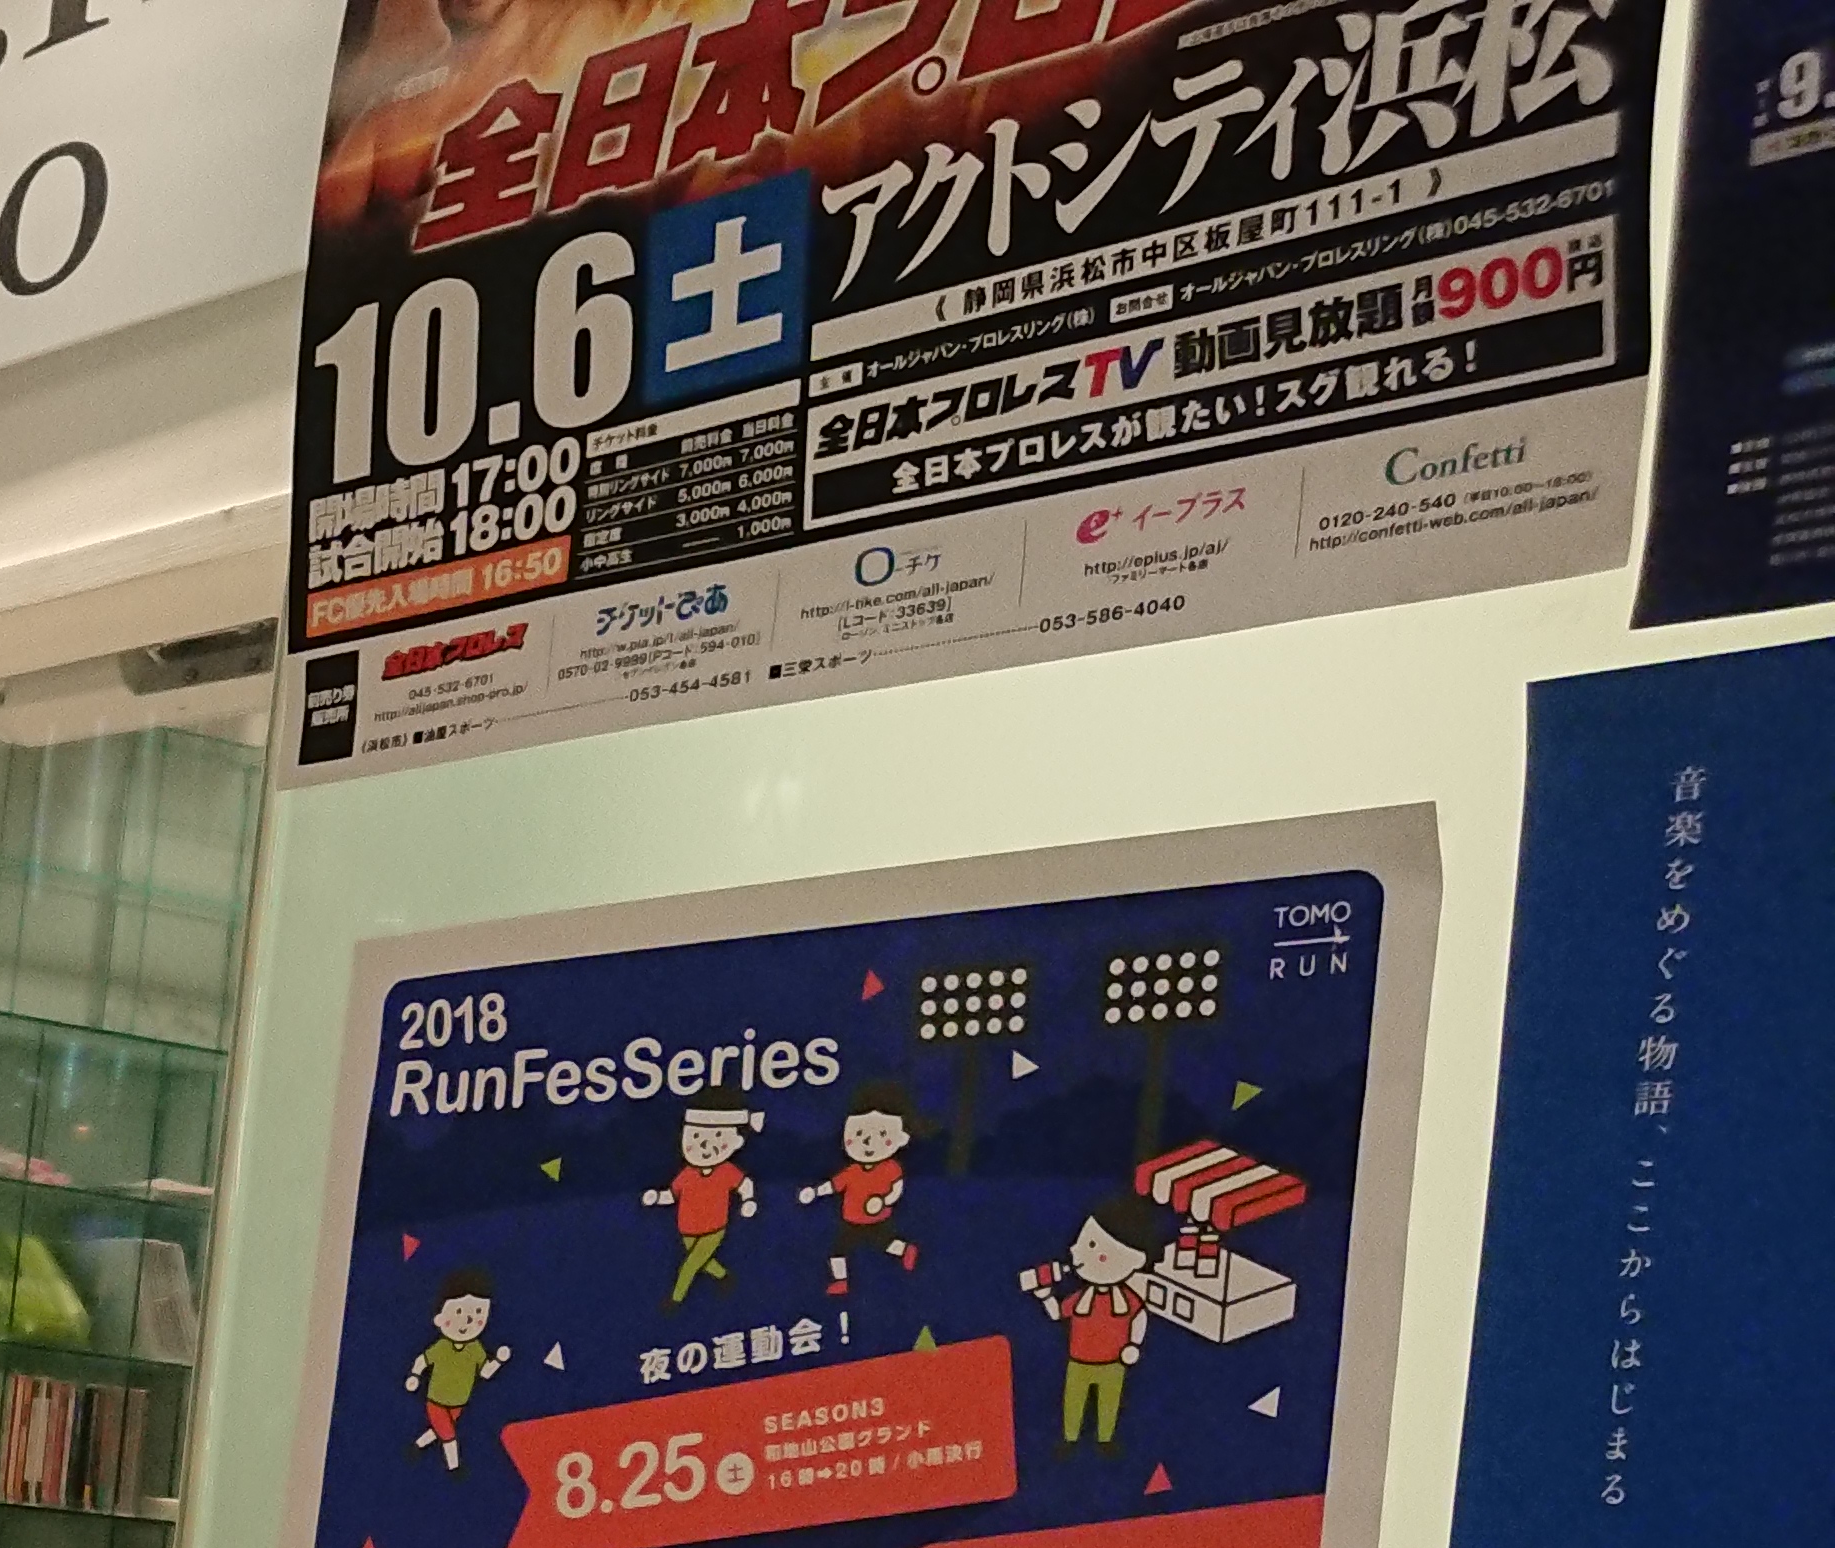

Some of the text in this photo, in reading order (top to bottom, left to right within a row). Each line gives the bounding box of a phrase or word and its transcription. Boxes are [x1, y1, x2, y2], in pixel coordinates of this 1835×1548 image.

[821, 0, 1613, 301] アクトシティ浜松
[1173, 281, 1404, 379] 動画見放題
[1437, 246, 1563, 320] 900
[314, 215, 783, 484] 10.6 土
[1384, 436, 1528, 486] Confetti
[308, 436, 581, 544] 開場時間 17:00
[1132, 487, 1247, 531] イープラス
[1318, 492, 1457, 531] 0120-240-540
[308, 485, 577, 589] 試合開始 18:00
[481, 548, 563, 589] 16:50
[596, 583, 729, 637] チケットぴあ
[1039, 594, 1186, 633] 053-586-4040
[629, 669, 751, 702] 053-454-4581
[1273, 901, 1351, 929] TOMO
[1269, 951, 1348, 980] RUN
[398, 992, 509, 1054] 2018
[388, 1025, 841, 1119] RunFesSeries
[763, 1396, 886, 1434] SEASON3
[555, 1432, 707, 1520] 8.25
